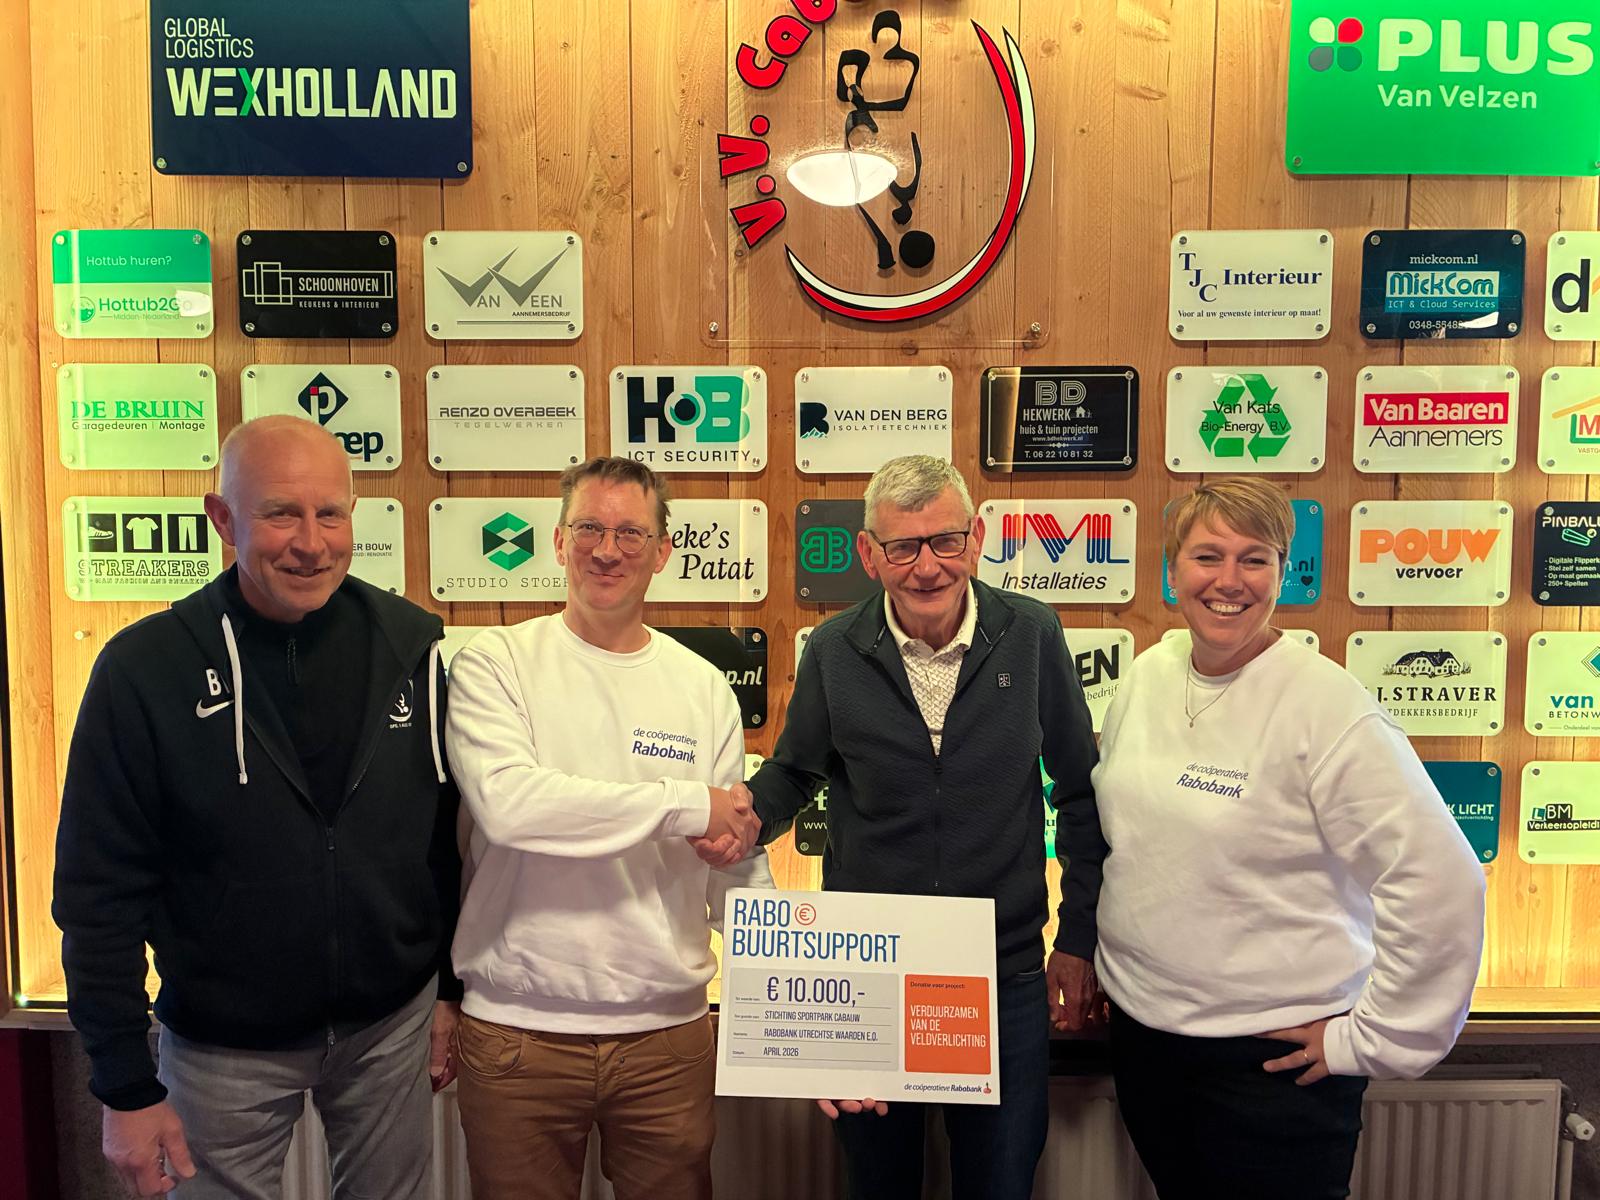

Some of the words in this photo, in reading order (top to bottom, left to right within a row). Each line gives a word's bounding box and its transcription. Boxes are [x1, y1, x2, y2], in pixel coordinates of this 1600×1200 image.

[164, 17, 232, 38] GLOBAL
[165, 38, 254, 59] LOGISTICS
[1377, 17, 1594, 76] PLUS
[166, 67, 457, 119] WEXHOLLAND
[1377, 84, 1432, 108] Van
[1439, 85, 1538, 109] Velzen
[86, 256, 127, 266] Hottub
[130, 256, 172, 266] huren?
[1409, 254, 1479, 265] mickcom.nl
[298, 277, 379, 292] SCHOONHOVEN
[1222, 268, 1323, 286] Interieur
[1389, 272, 1494, 295] MickCom
[341, 301, 380, 309] INTERIEUR
[1388, 300, 1404, 308] ICT
[1419, 300, 1447, 308] Cloud
[1452, 300, 1496, 309] Services
[1177, 310, 1194, 318] Voor
[1219, 311, 1251, 319] gewenste
[1253, 309, 1287, 317] interieur
[1288, 310, 1298, 318] op
[1034, 380, 1087, 406] BD
[71, 400, 107, 418] DE
[115, 400, 204, 418] BRUIN
[439, 407, 490, 417] RENZO
[493, 407, 576, 417] OVERBEEK
[833, 409, 865, 421] VAN
[870, 409, 901, 421] DEN
[906, 409, 947, 421] BERG
[1022, 408, 1071, 421] HEKWERK
[1212, 401, 1242, 414] Van
[1247, 401, 1280, 414] Kats
[1369, 398, 1414, 421] Van
[1418, 398, 1504, 421] Baaren
[72, 421, 147, 432] Garagedeuren
[159, 421, 206, 432] Montage
[1020, 424, 1036, 434] huis
[1037, 425, 1044, 434] &
[1045, 425, 1060, 434] tuin
[1062, 424, 1098, 436] projecten
[1201, 421, 1264, 434] Bio-Energy
[1270, 421, 1289, 431] B.V.
[1368, 426, 1503, 447] Aannemers
[628, 451, 655, 462] ICT
[664, 450, 751, 462] SECURITY
[1083, 450, 1094, 458] 32
[365, 543, 392, 551] BOUW
[1359, 528, 1501, 565] POUW
[78, 559, 210, 577] STREAKERS
[678, 553, 754, 580] Patat
[1396, 568, 1463, 579] vervoer
[446, 577, 509, 588] STUDIO
[1001, 572, 1107, 590] Installaties
[722, 666, 763, 686] p.nl
[1550, 695, 1594, 709] van
[633, 727, 645, 737] de
[646, 730, 698, 747] coöperatieve
[632, 740, 696, 765] Rabobank
[1186, 762, 1198, 772] de
[1197, 765, 1249, 780] coöperatieve
[1176, 773, 1244, 798] Rabobank
[1459, 804, 1495, 815] LICHT
[1546, 805, 1572, 819] BM
[733, 898, 791, 927] RABO
[732, 928, 900, 963] BUURTSUPPORT
[767, 976, 779, 1002] €
[785, 977, 866, 1008] 10.000,-
[764, 1010, 797, 1021] STICHTING
[797, 1011, 833, 1022] SPORTPARK
[834, 1012, 860, 1022] CABAUW
[910, 1004, 979, 1019] VERDUURZAMEN
[910, 1019, 927, 1031] VAN
[930, 1019, 941, 1031] DE
[764, 1028, 797, 1038] RABOBANK
[799, 1029, 834, 1039] UTRECHTSE
[835, 1030, 866, 1041] WAARDEN
[910, 1032, 986, 1048] VELDVERLICHTING
[763, 1047, 781, 1056] APRIL
[782, 1047, 799, 1057] 2026
[950, 1084, 982, 1093] Rabobank
